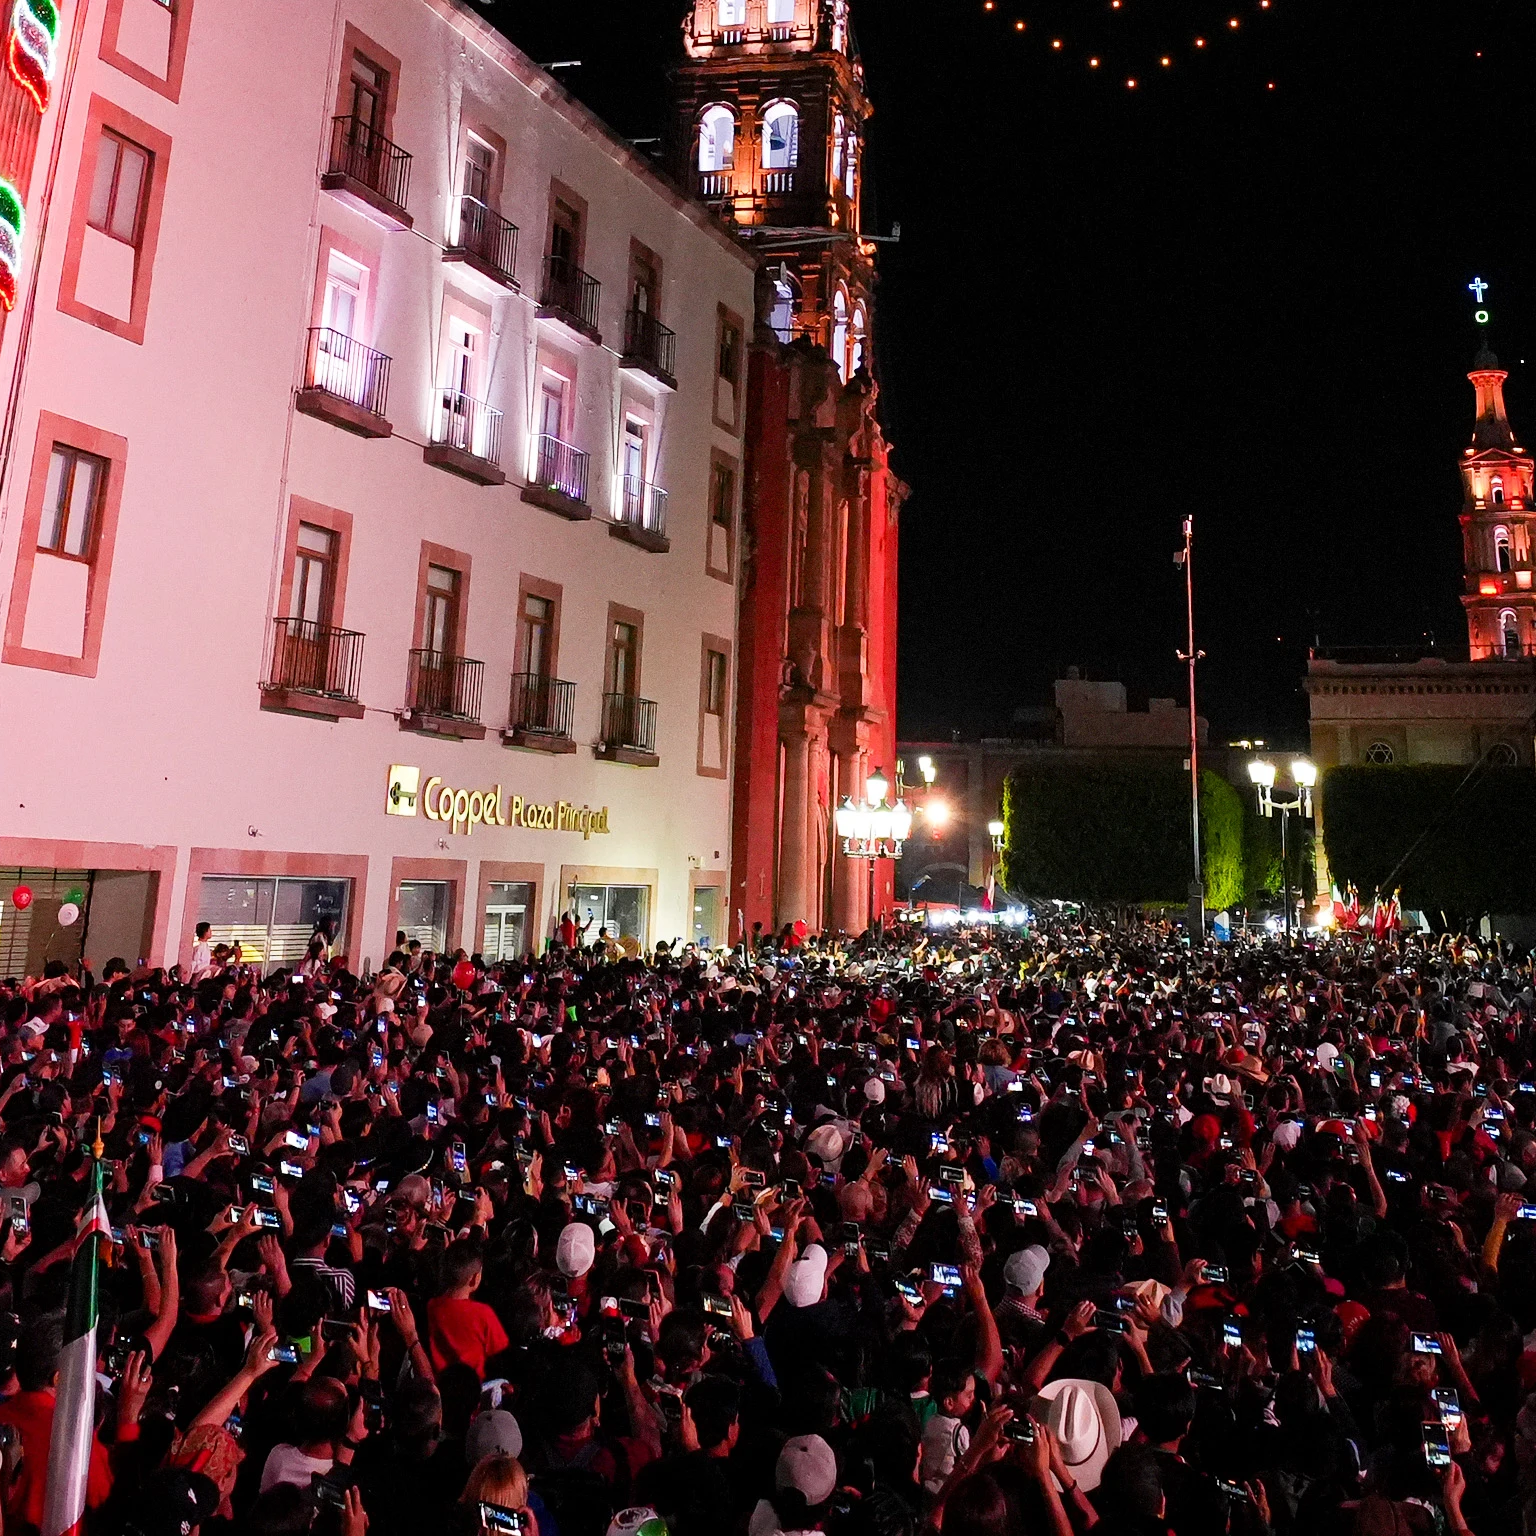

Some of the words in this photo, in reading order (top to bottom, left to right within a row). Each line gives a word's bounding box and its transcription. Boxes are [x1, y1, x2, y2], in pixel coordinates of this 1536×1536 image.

[423, 776, 505, 835] Coppel
[510, 795, 554, 830] Plaza
[555, 800, 611, 840] Principal
